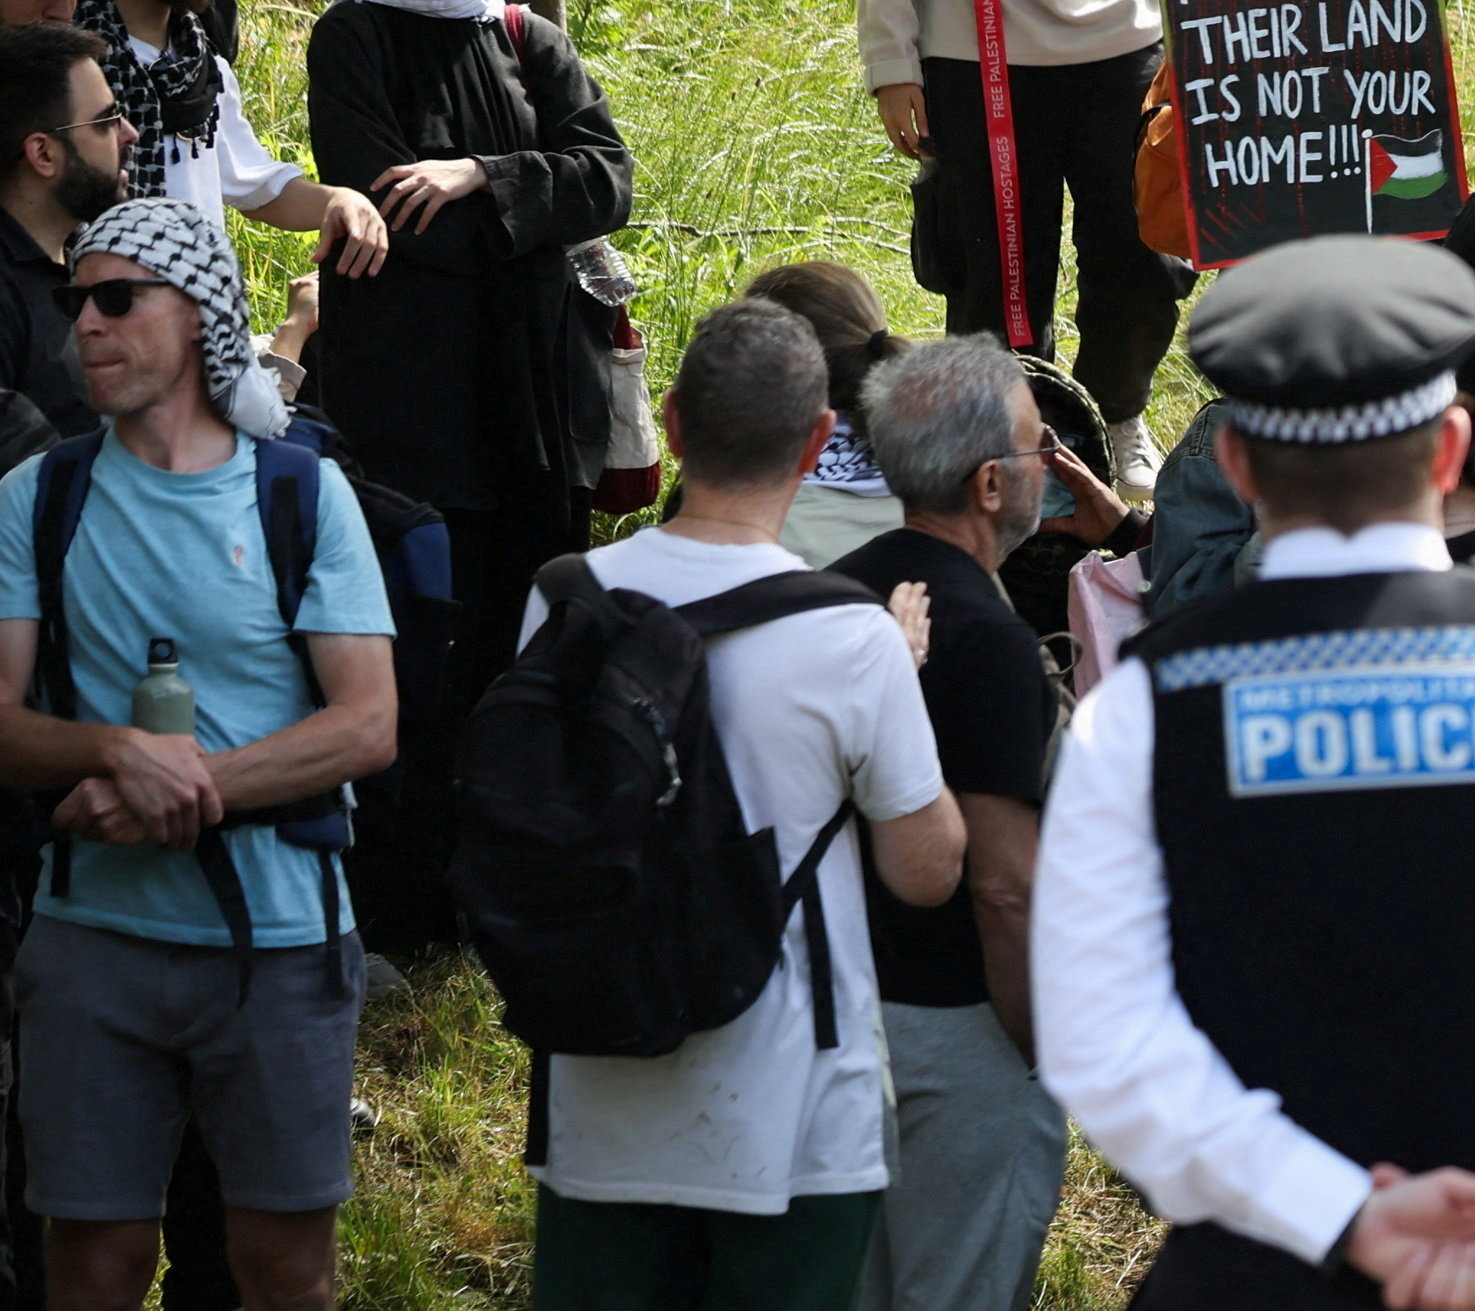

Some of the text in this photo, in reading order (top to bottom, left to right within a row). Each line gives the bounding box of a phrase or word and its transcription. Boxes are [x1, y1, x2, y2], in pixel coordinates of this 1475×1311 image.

[1181, 4, 1309, 64] THEIR
[991, 86, 1005, 118] FREE
[1185, 66, 1436, 126] IS NOT YOUR
[1205, 124, 1362, 189] HOME!!!
[997, 136, 1025, 336] FREE PALESTINIAN HOSTAGES
